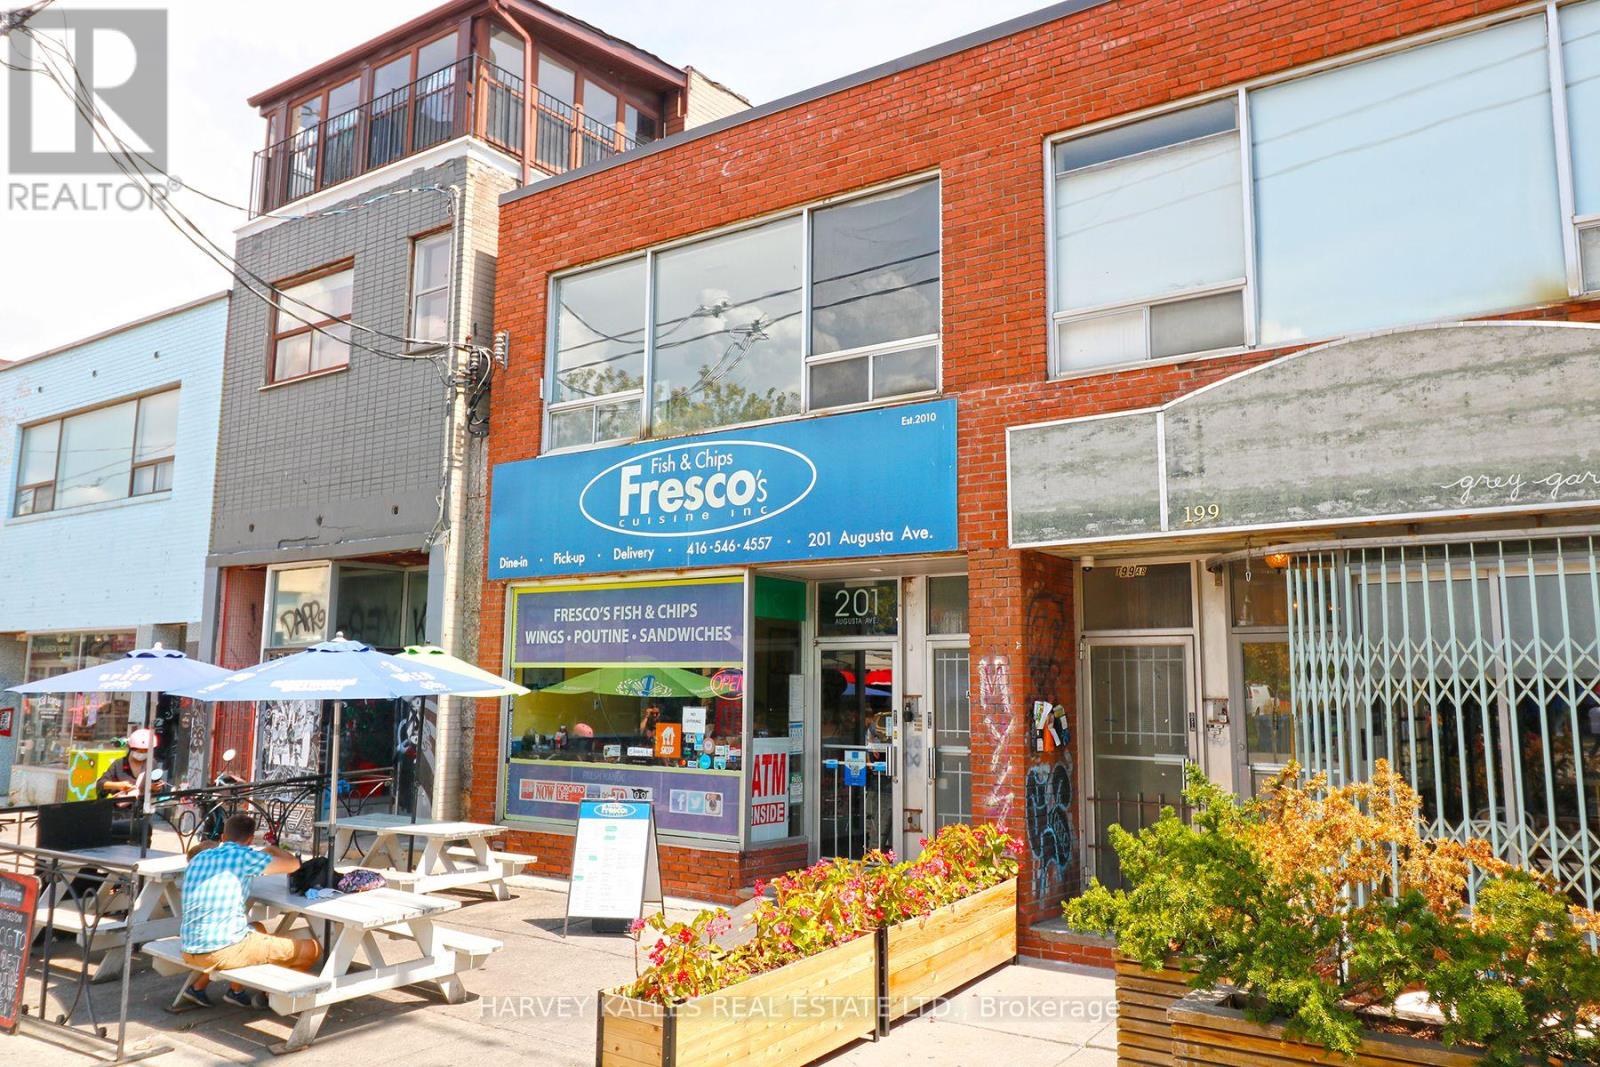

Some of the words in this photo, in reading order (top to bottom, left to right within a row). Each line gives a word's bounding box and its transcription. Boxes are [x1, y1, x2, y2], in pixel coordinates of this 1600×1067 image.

[901, 412, 937, 426] Est.2010
[651, 453, 676, 474] Fish
[680, 453, 691, 470] &
[695, 449, 733, 471] Chips
[619, 464, 768, 517] Fresco's
[1440, 473, 1527, 505] grey
[1183, 503, 1219, 523] 199
[499, 556, 528, 569] Dine-in
[553, 552, 585, 566] Pick-up
[613, 547, 655, 561] Delivery
[808, 531, 831, 547] 201
[839, 529, 894, 547] Augusta
[901, 525, 933, 541] Ave.
[554, 605, 610, 622] FRESCO'S
[613, 604, 641, 620] FISH
[644, 603, 655, 619] &
[657, 603, 698, 619] CHIPS
[835, 588, 878, 617] 201
[835, 616, 862, 625] AUGUSTA
[525, 630, 564, 644] WINGS
[574, 629, 629, 643] POUTINE
[639, 626, 732, 643] SANDWICHES
[752, 753, 786, 797] ATM
[535, 783, 555, 800] NOW
